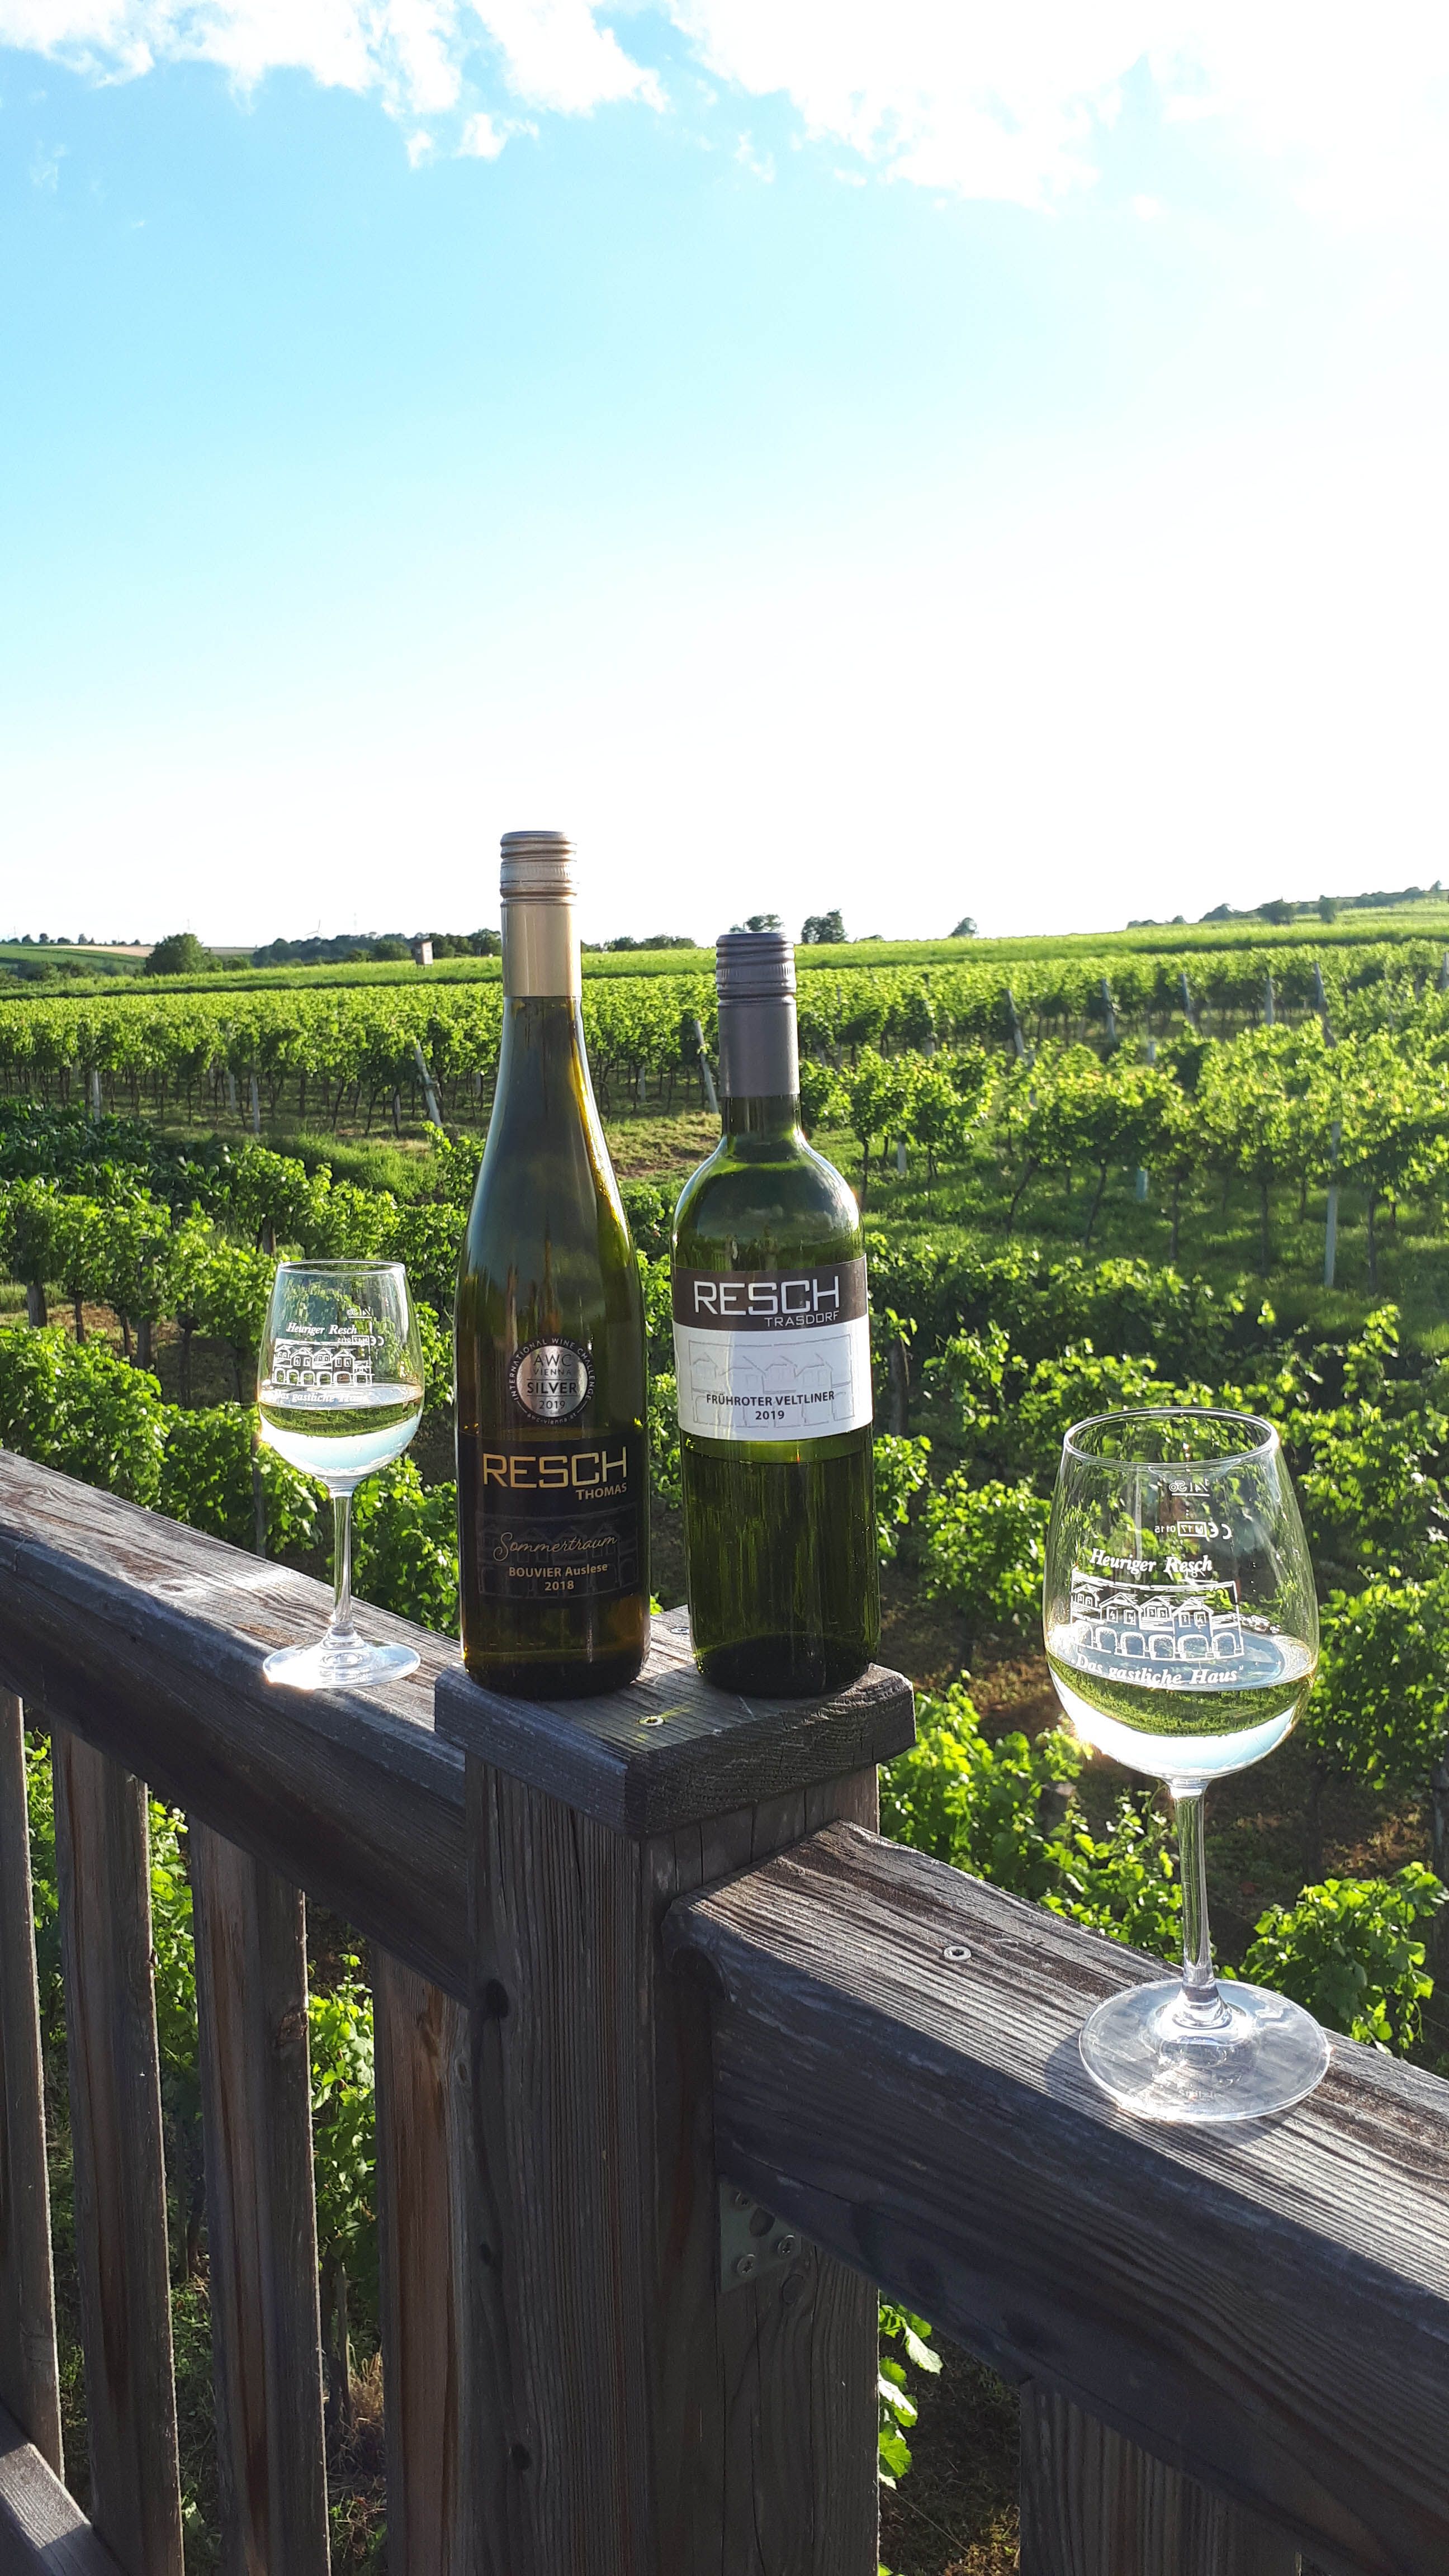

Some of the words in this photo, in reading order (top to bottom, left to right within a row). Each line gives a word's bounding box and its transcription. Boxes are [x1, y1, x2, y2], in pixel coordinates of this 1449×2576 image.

[694, 1276, 839, 1315] RESCH
[764, 1310, 839, 1328] TRASDORF
[286, 1322, 325, 1336] Heuriger
[328, 1324, 357, 1335] Resch
[509, 1338, 547, 1400] INTERNATIONAL
[552, 1338, 575, 1348] WINE
[577, 1348, 595, 1400] CHALLENGE
[533, 1354, 572, 1367] AWC
[527, 1382, 577, 1394] SILVER
[291, 1391, 335, 1403] gastliche
[539, 1400, 566, 1410] 2019
[706, 1393, 773, 1407] FRÜHROTER
[776, 1390, 835, 1406] VELTLINER
[755, 1410, 785, 1421] 2019
[482, 1446, 627, 1489] RESCH
[575, 1482, 627, 1501] THOMAS
[493, 1531, 617, 1561] Sommertraum
[1089, 1547, 1157, 1575] Heuriger
[1163, 1555, 1213, 1573] Resch
[509, 1566, 562, 1578] BOUVIER
[565, 1563, 608, 1576] Auslese
[544, 1580, 575, 1592] 2018
[1108, 1666, 1182, 1685] gastliche
